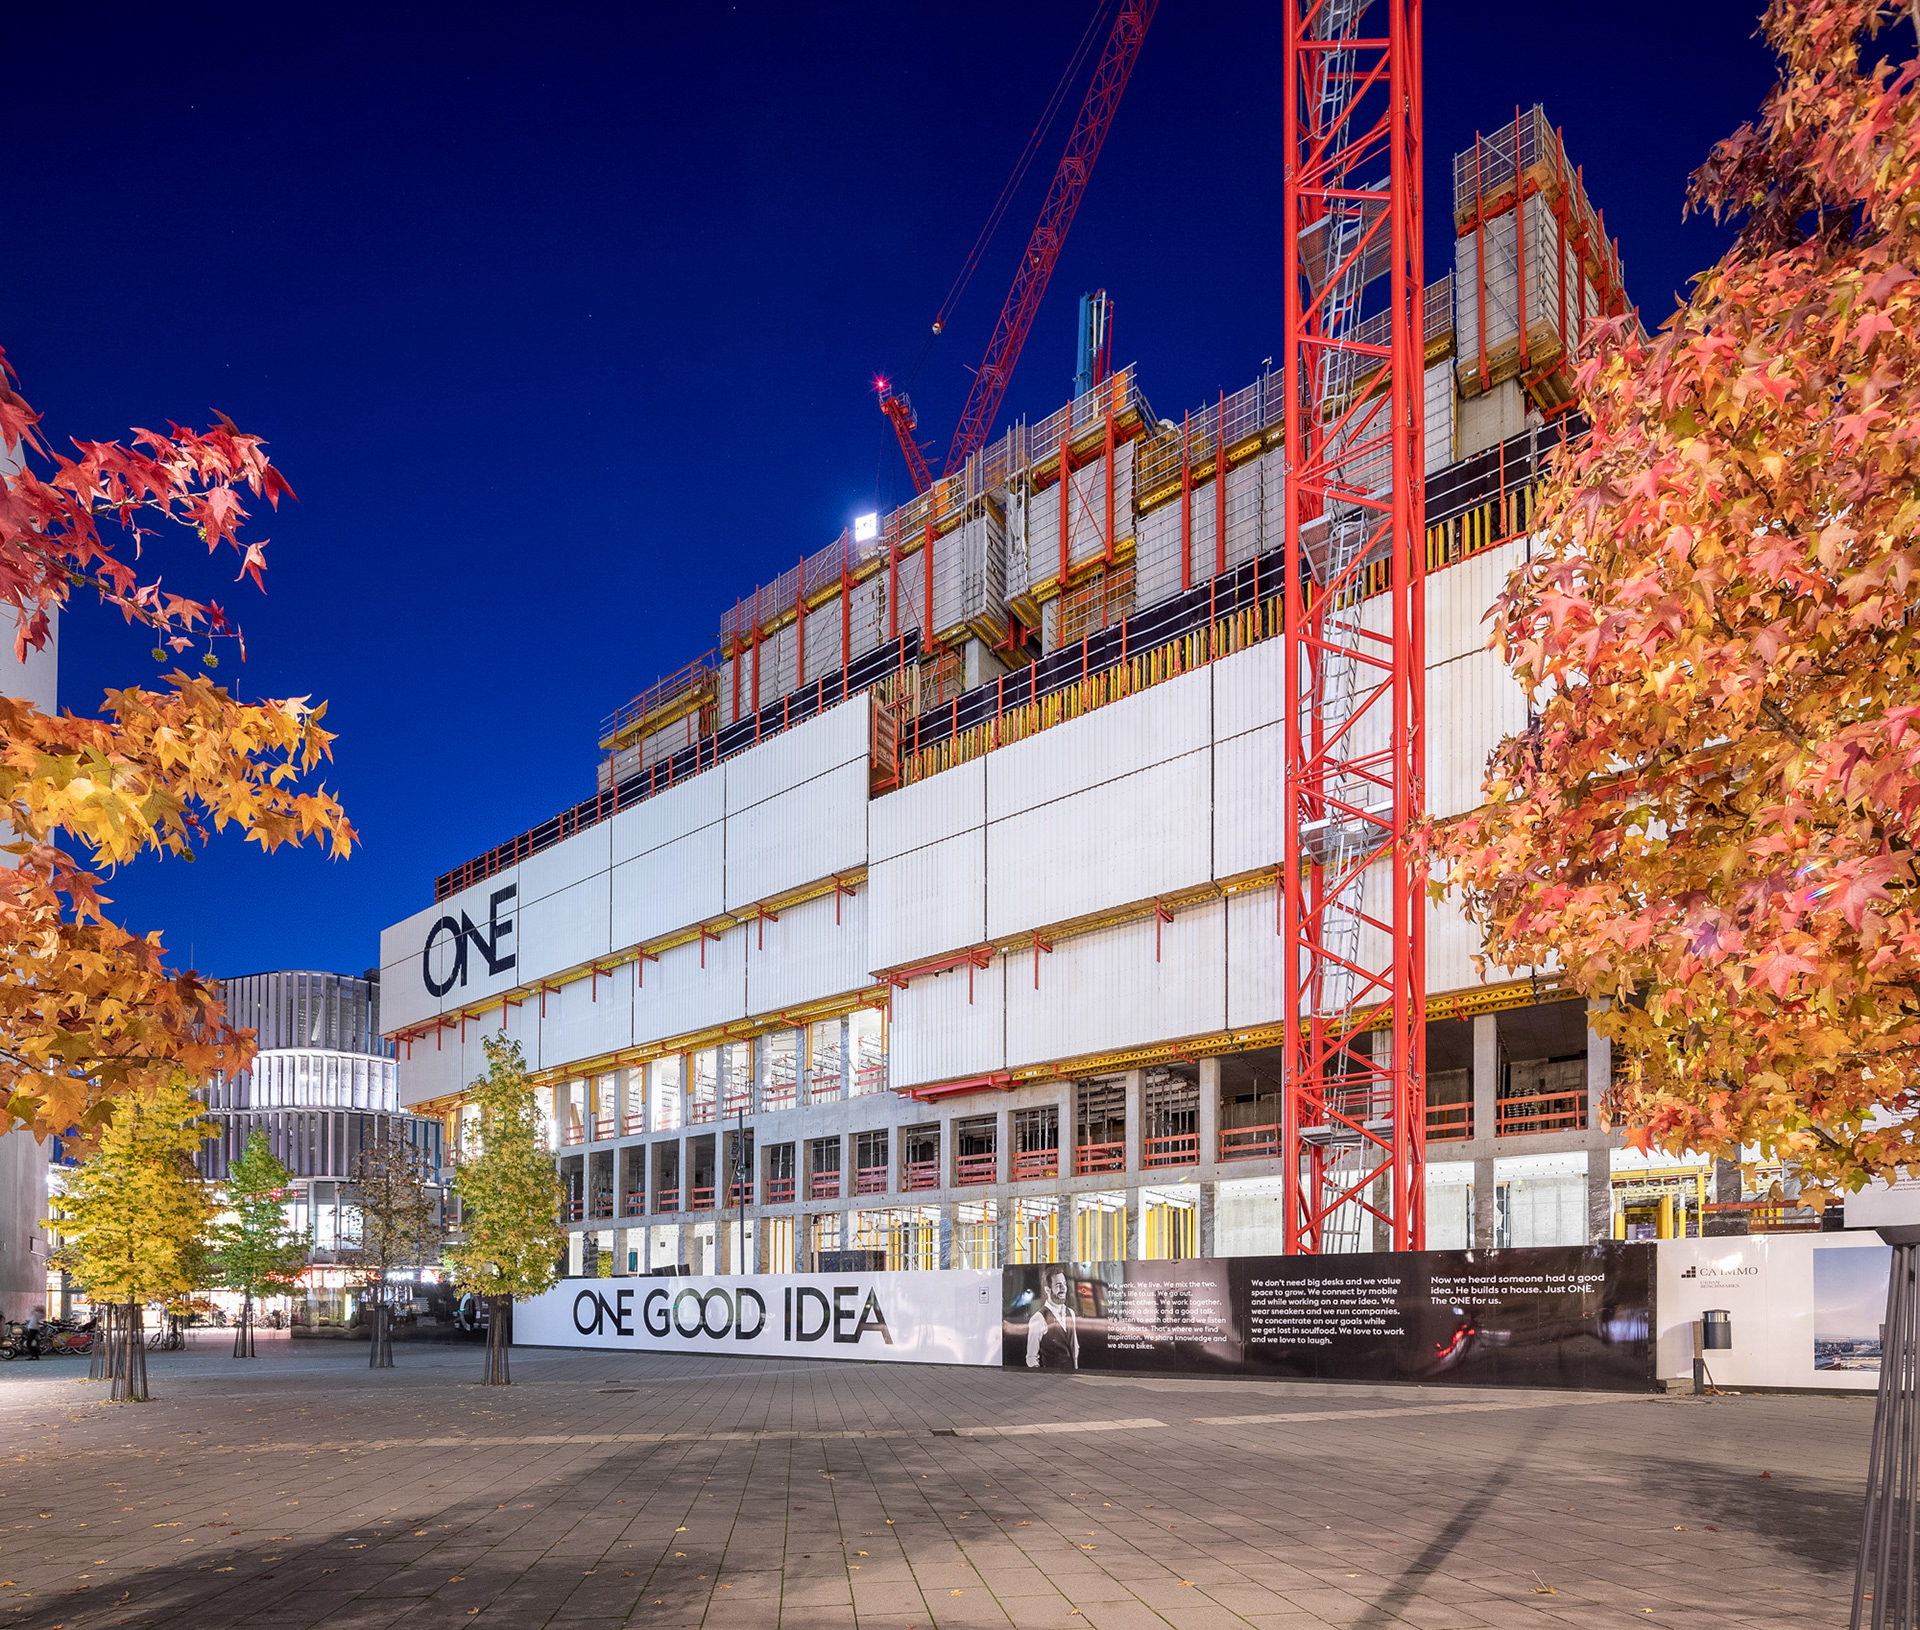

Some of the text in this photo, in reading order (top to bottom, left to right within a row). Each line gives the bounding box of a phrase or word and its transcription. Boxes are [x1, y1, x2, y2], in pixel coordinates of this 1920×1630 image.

[423, 882, 517, 997] ONE
[1700, 1268, 1716, 1276] CA
[1577, 1274, 1604, 1282] good
[1307, 1278, 1320, 1287] big
[1356, 1288, 1367, 1296] by
[1288, 1298, 1319, 1306] working
[573, 1286, 893, 1345] ONE GOOD IDEA
[1340, 1317, 1362, 1326] goals
[1307, 1337, 1332, 1345] laugh.
